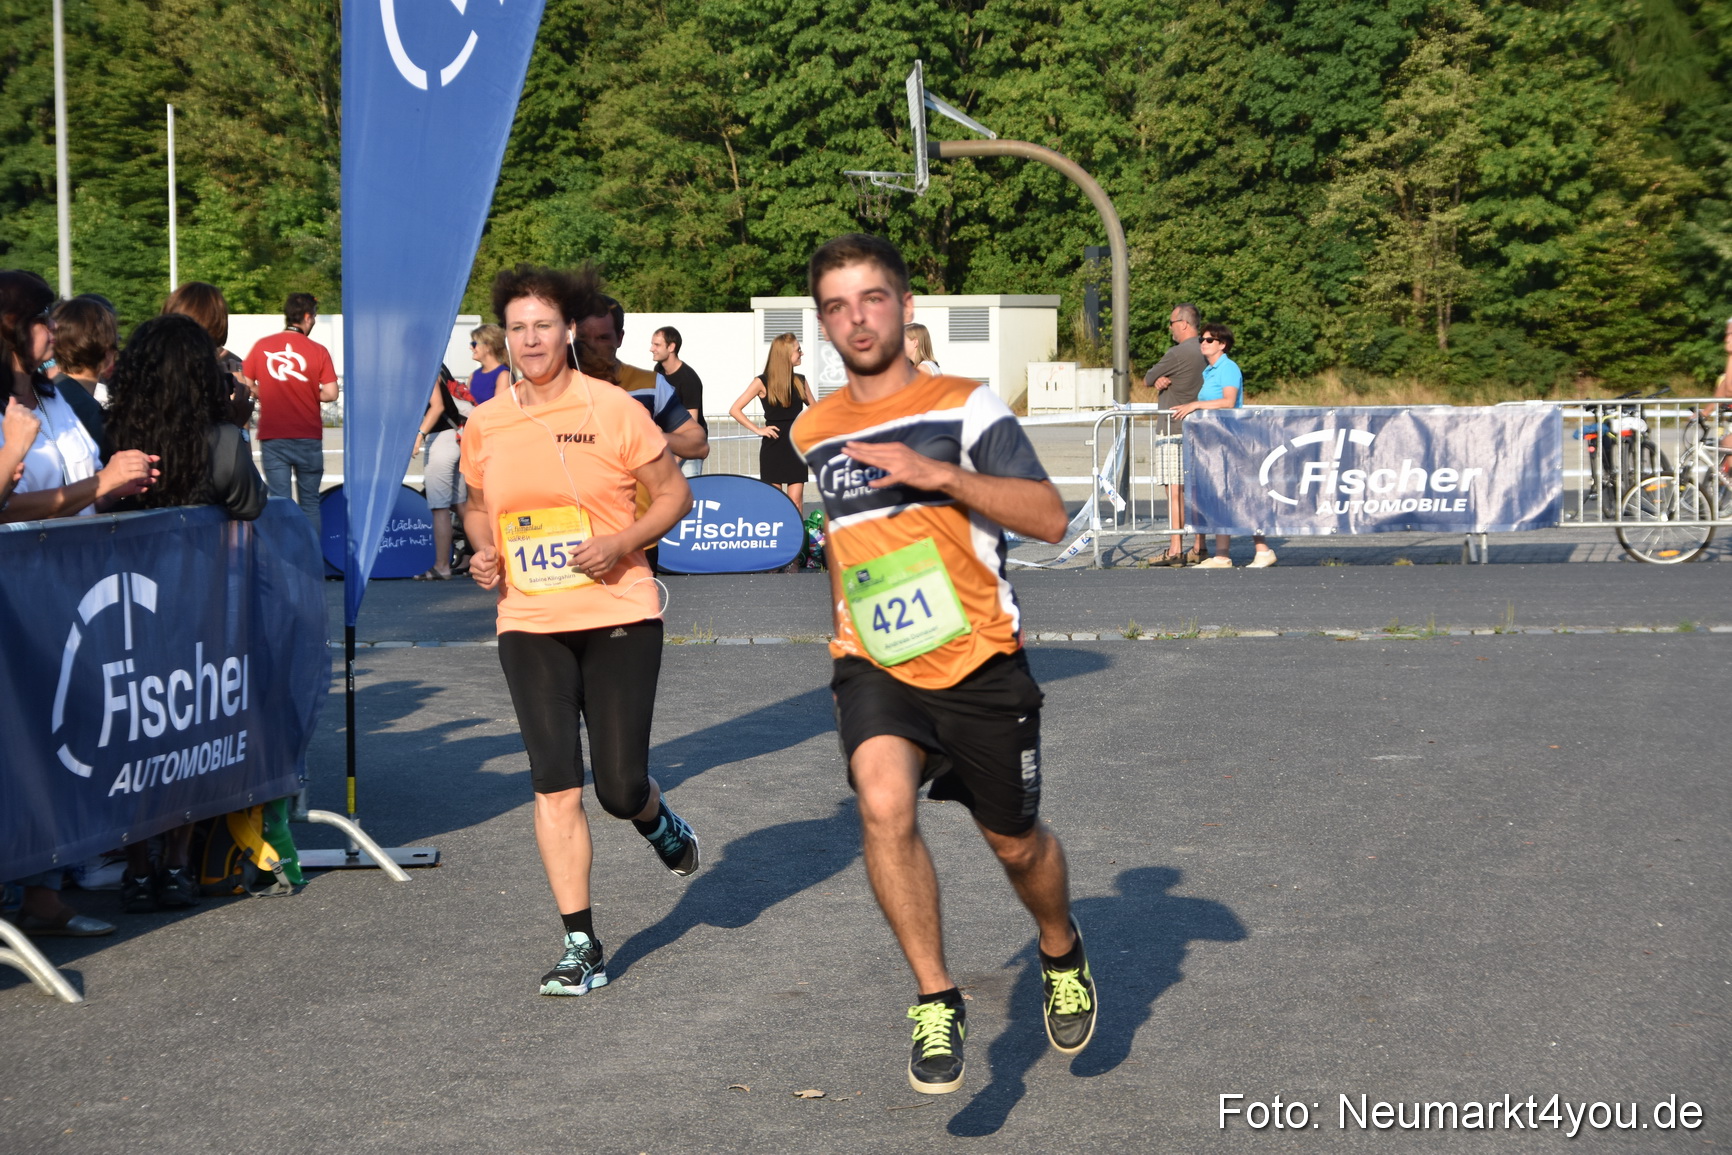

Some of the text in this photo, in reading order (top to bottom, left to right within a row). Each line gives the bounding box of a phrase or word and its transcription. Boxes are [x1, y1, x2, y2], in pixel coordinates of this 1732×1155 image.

[556, 433, 595, 444] THULE
[833, 466, 891, 490] Fisc
[1300, 459, 1482, 495] Fischer
[1316, 498, 1467, 515] AUTOMOBILE
[409, 534, 432, 546] mit!
[680, 517, 783, 540] Fischer
[691, 540, 777, 551] AUTOMOBILE
[873, 588, 932, 634] 421
[108, 730, 247, 797] AUTOMOBILE
